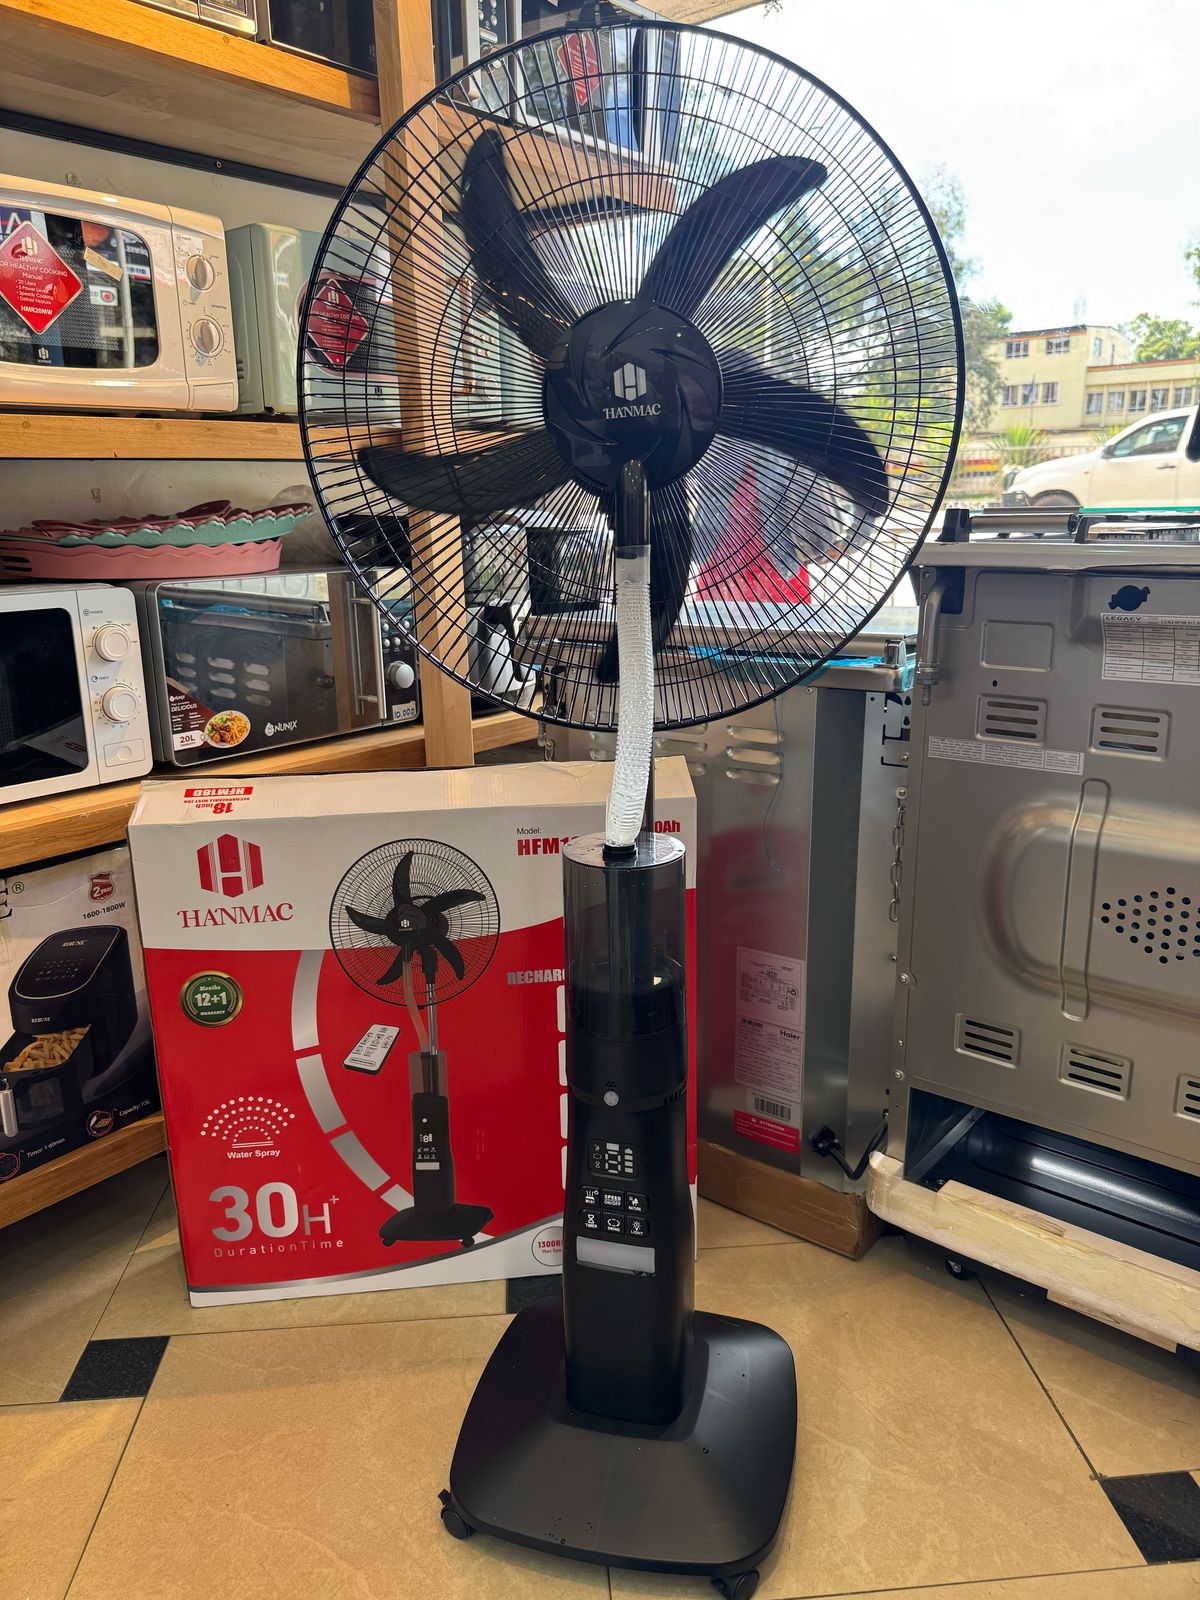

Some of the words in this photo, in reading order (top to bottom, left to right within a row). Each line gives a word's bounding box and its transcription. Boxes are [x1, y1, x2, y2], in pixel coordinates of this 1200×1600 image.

[10, 262, 39, 272] HEALTHY
[40, 268, 68, 277] COOKING
[22, 271, 43, 280] Manual
[602, 403, 661, 420] HANMAC
[171, 703, 198, 712] DELICIOUS
[275, 720, 298, 732] NUNIX
[180, 735, 195, 744] 20L
[193, 788, 245, 797] HFM18D
[212, 802, 234, 814] 18
[516, 827, 541, 835] Model:
[517, 836, 572, 856] HFM
[93, 886, 101, 897] 2
[82, 901, 126, 920] 1600-1800W
[176, 902, 294, 928] HANMAC
[507, 968, 565, 985] RECHAR
[194, 991, 227, 1007] 12+1
[780, 1029, 801, 1041] Haier
[119, 1104, 140, 1117] Capacity:
[26, 1147, 44, 1158] Timer:
[44, 1137, 66, 1151] 1-60min
[227, 1151, 253, 1159] Water
[255, 1149, 281, 1158] Spray
[538, 1239, 561, 1248] 1300R
